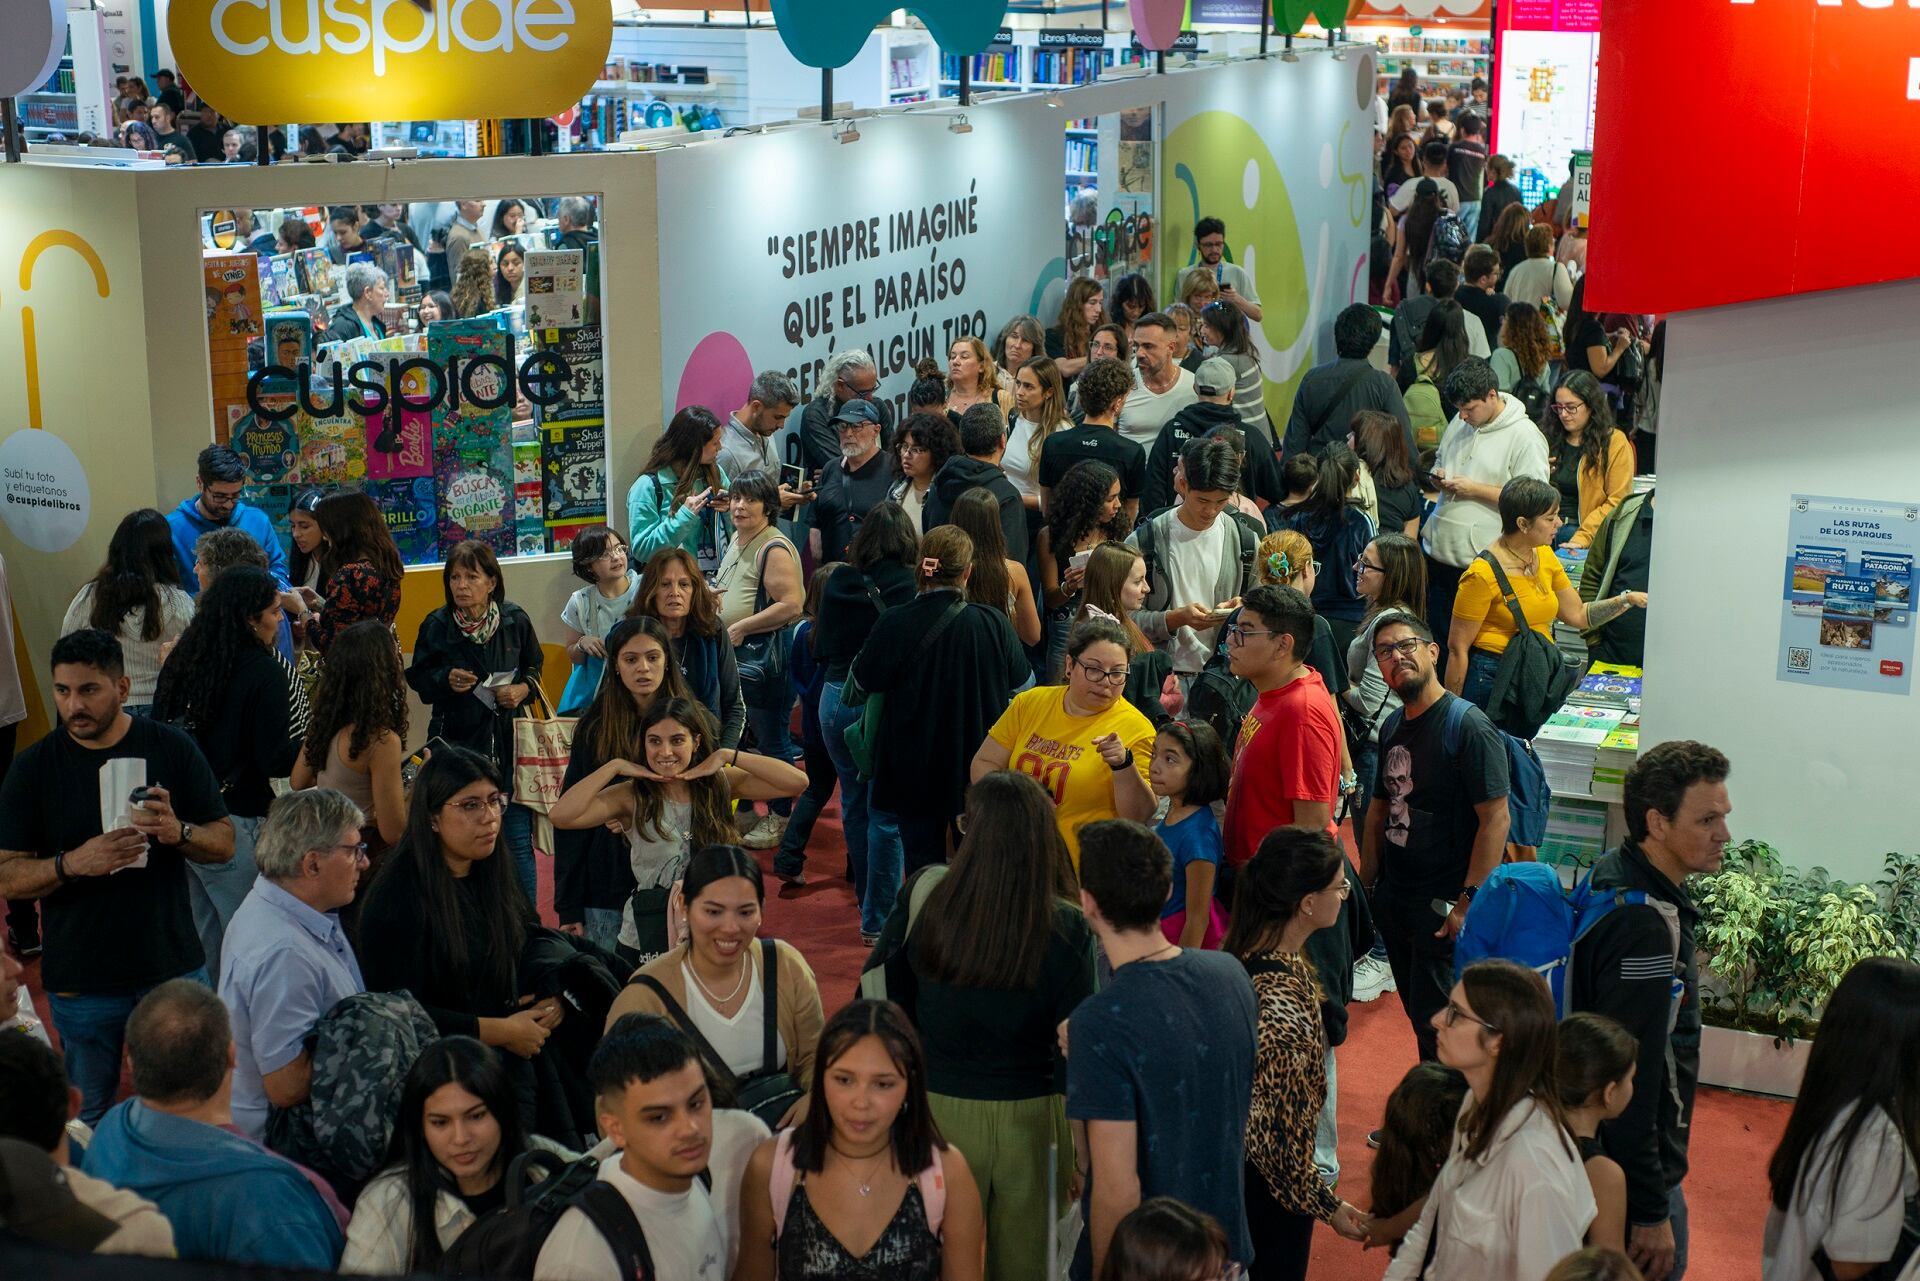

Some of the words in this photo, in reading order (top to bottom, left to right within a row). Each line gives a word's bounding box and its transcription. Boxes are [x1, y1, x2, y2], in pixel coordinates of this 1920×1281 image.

[1040, 33, 1066, 44] Libros
[1067, 32, 1103, 45] Técnicos
[767, 216, 880, 279] "SIEMPRE
[889, 178, 978, 254] IMAGINÉ
[783, 291, 834, 348] QUE
[842, 283, 867, 329] EL
[874, 246, 967, 319] PARAÍSO
[942, 309, 987, 358] TIPO
[570, 339, 600, 352] Puppet
[398, 417, 425, 467] Barbie
[26, 470, 35, 480] tu
[37, 471, 56, 483] foto
[5, 482, 11, 492] y
[13, 482, 68, 497] etiquetanos
[452, 475, 496, 498] BUSCA
[6, 493, 81, 511] @cuspidelibros
[451, 498, 501, 520] GIGANTE
[1833, 519, 1850, 528] LAS
[1852, 521, 1880, 530] RUTAS
[1819, 527, 1832, 535] DE
[1833, 528, 1850, 537] LOS
[1851, 530, 1893, 540] PARQUES
[1864, 562, 1907, 572] PATAGONIA
[1832, 583, 1856, 592] RUTA
[1857, 585, 1870, 593] 40
